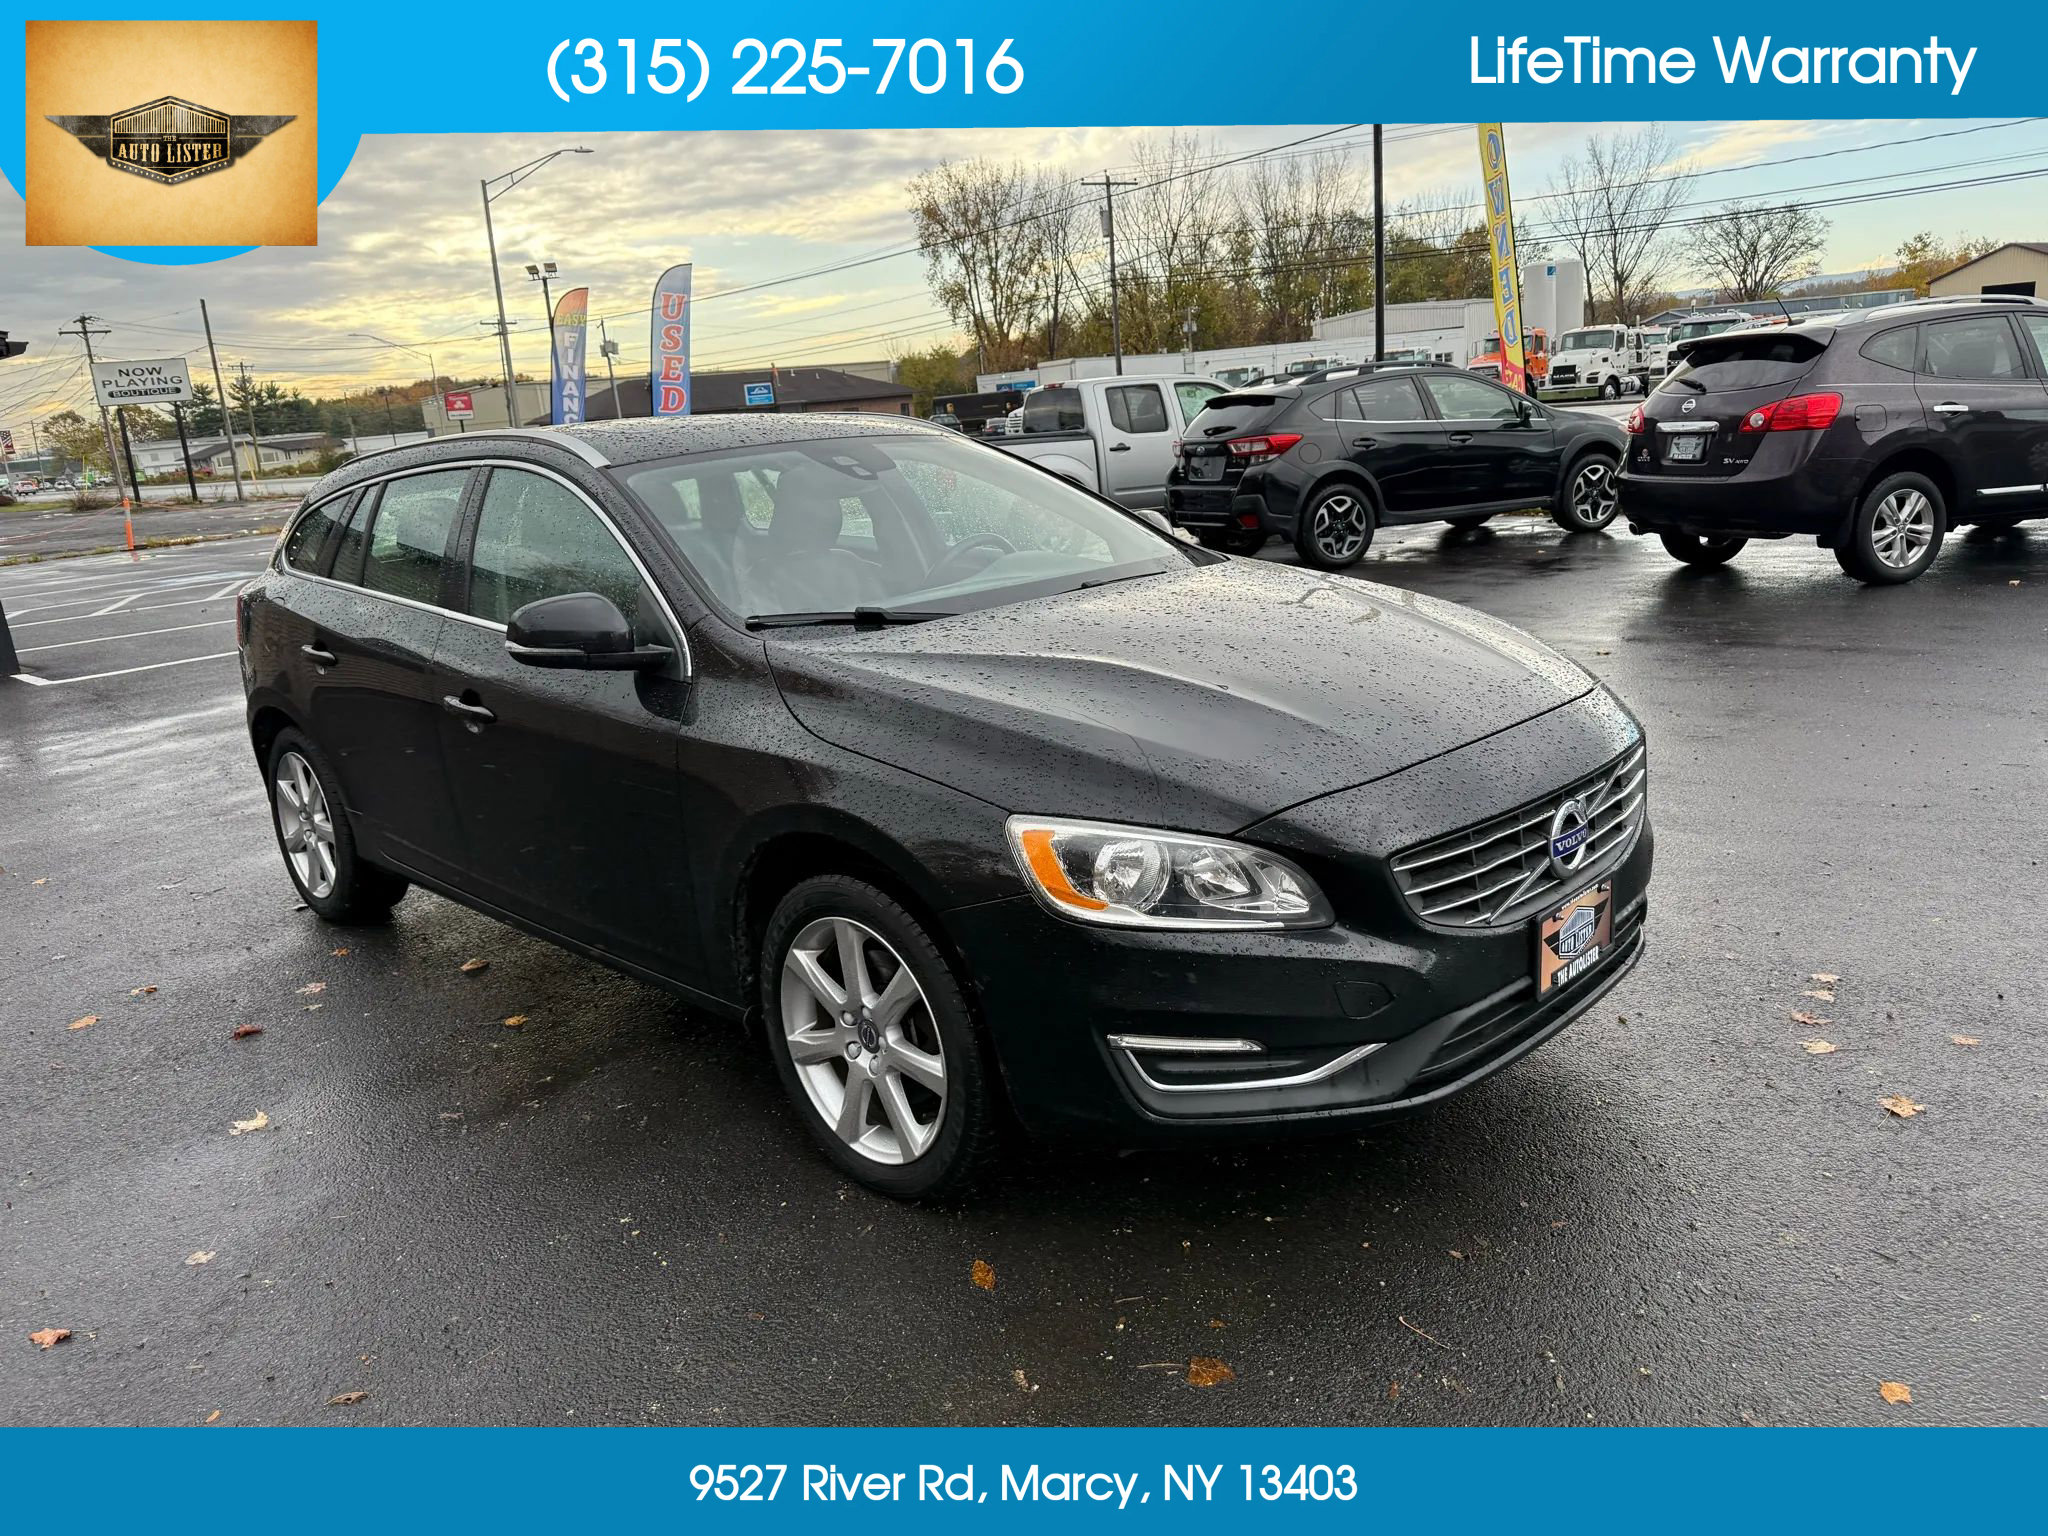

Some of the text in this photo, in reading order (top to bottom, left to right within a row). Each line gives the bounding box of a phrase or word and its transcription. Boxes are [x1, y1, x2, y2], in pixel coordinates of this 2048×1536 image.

[556, 314, 587, 326] EASY
[659, 292, 687, 413] USED
[118, 366, 162, 377] NOW
[102, 375, 183, 389] PLAYING
[113, 387, 177, 398] BOUTIQUE
[1555, 828, 1587, 851] VOLVO
[1561, 924, 1593, 953] AUTO LISTER
[1557, 945, 1599, 987] THE AUTOLISTER
